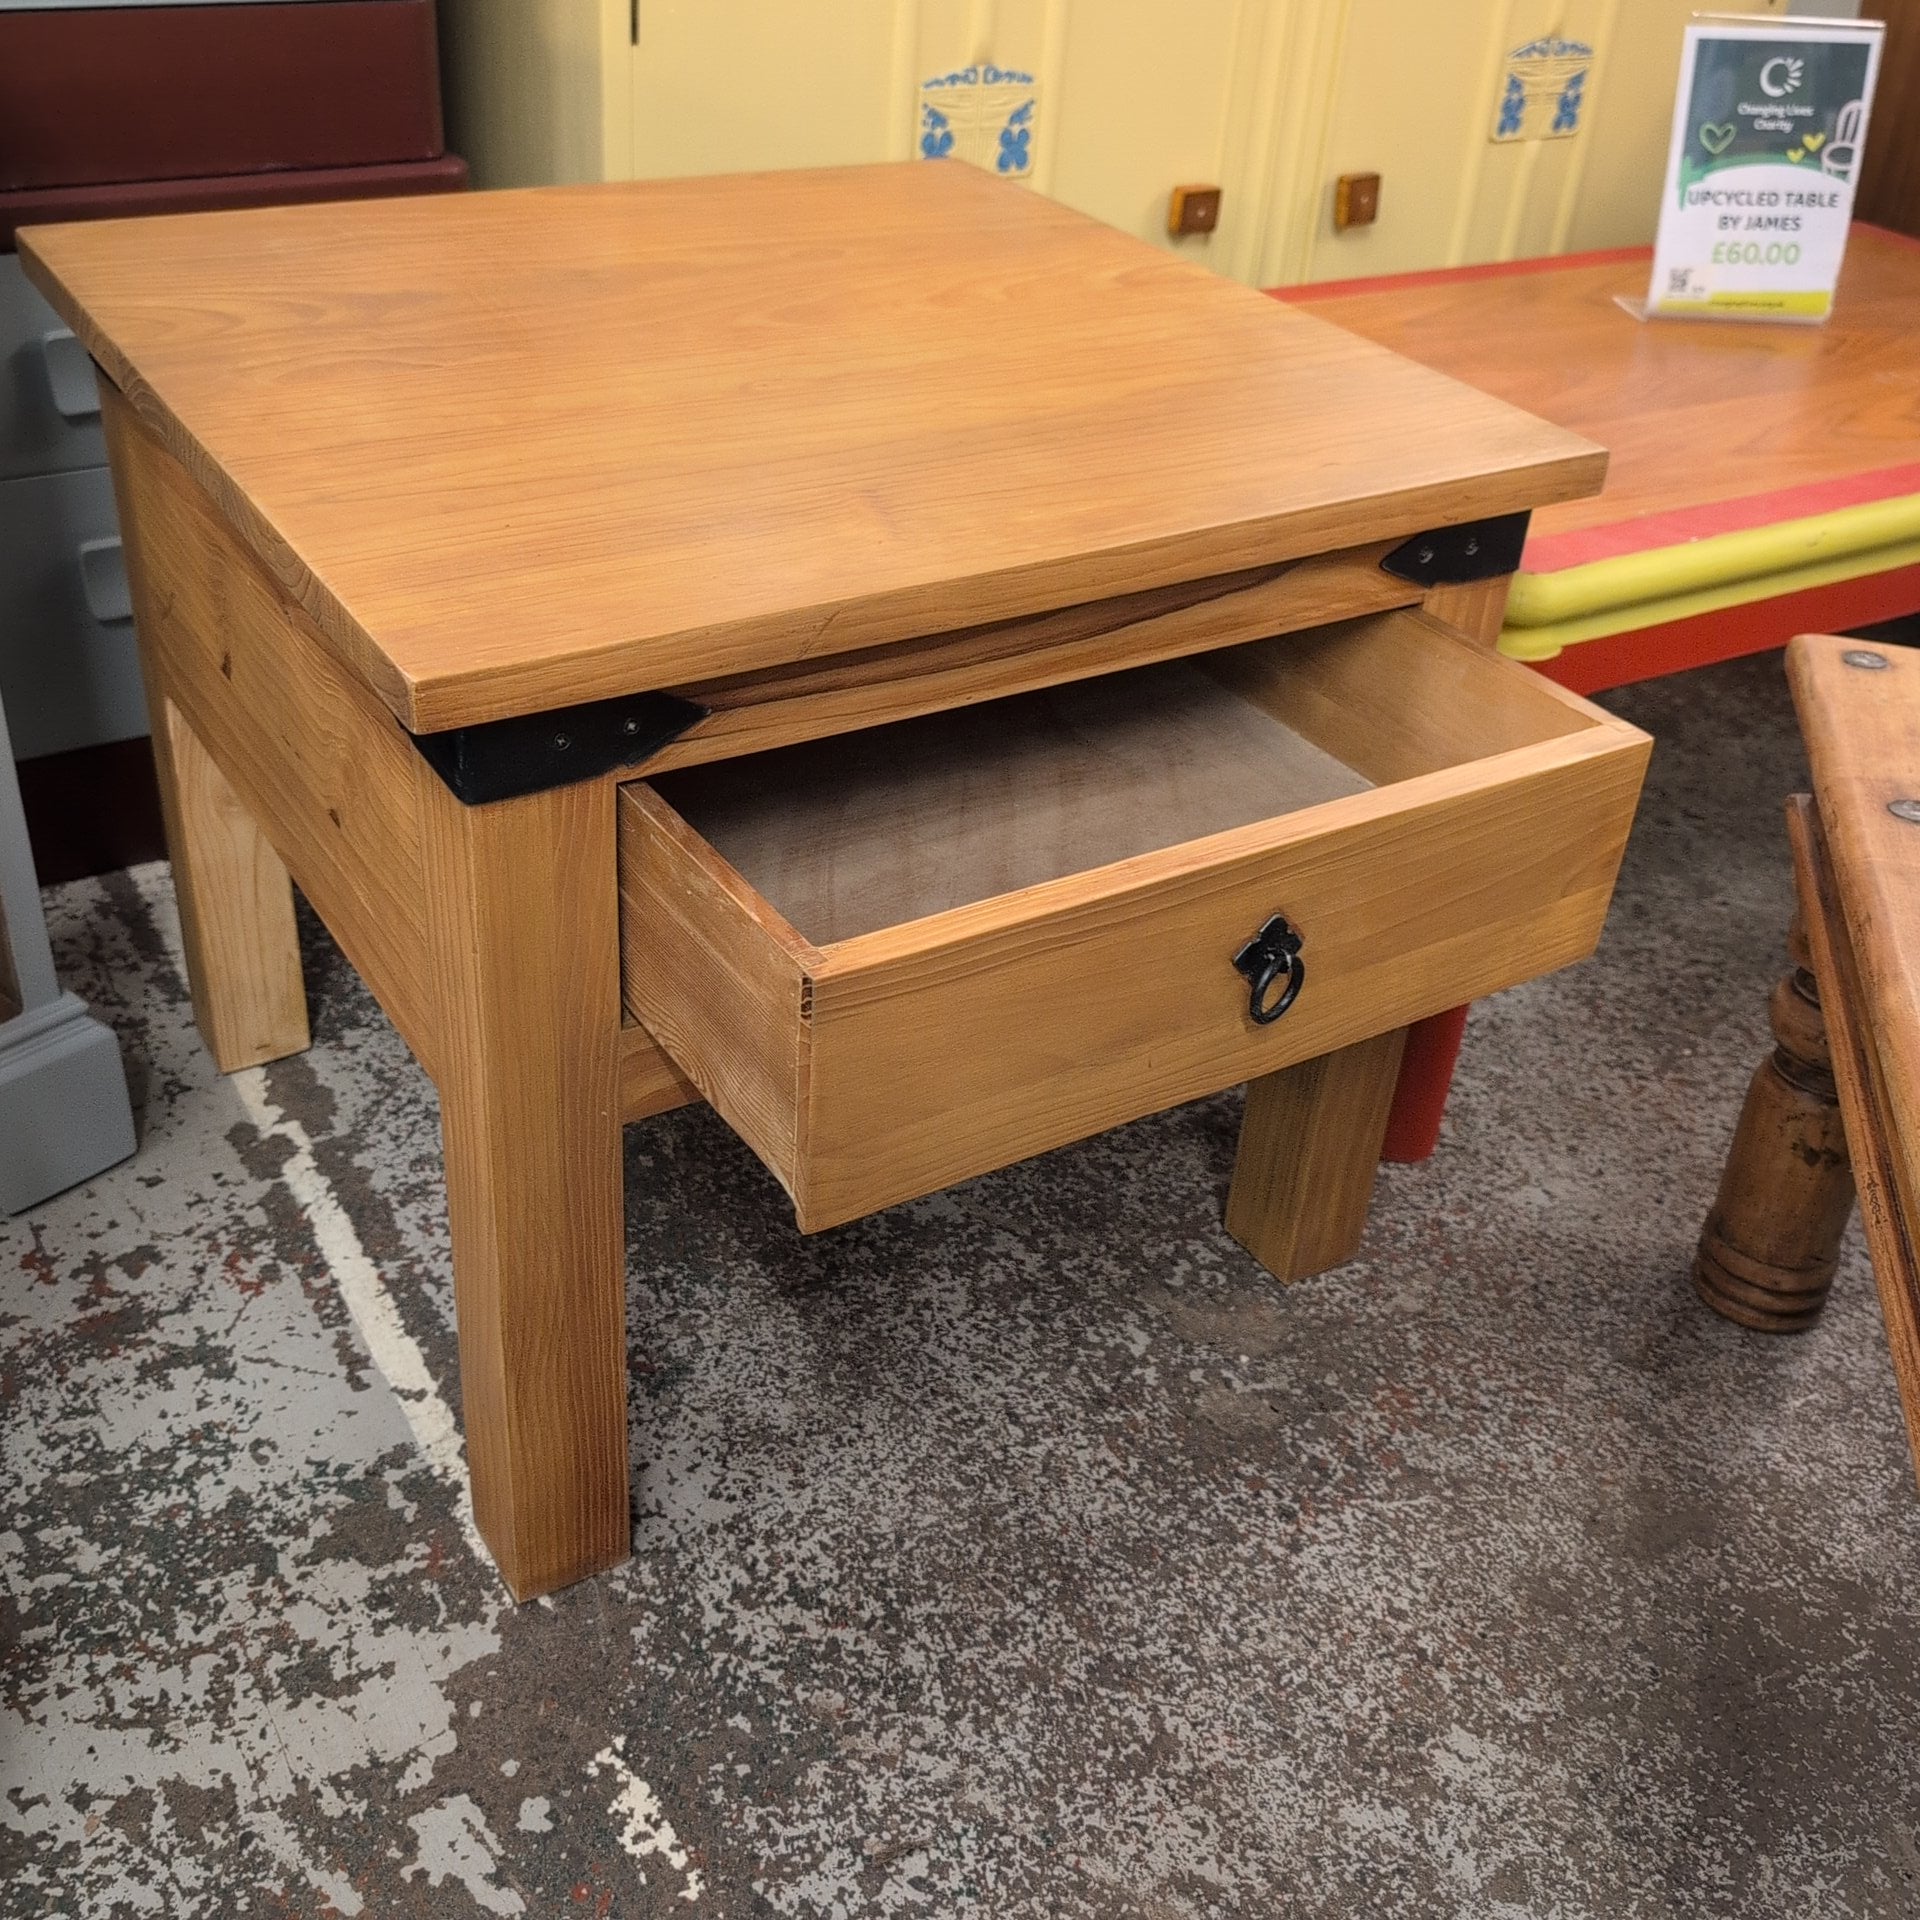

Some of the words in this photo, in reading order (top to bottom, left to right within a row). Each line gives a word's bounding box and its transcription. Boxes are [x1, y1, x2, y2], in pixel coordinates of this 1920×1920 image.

[1688, 191, 1778, 207] UPCYCLED
[1785, 193, 1839, 208] TABLE
[1718, 215, 1741, 231] BY
[1744, 216, 1802, 232] JAMES
[1711, 242, 1801, 266] £60.00
